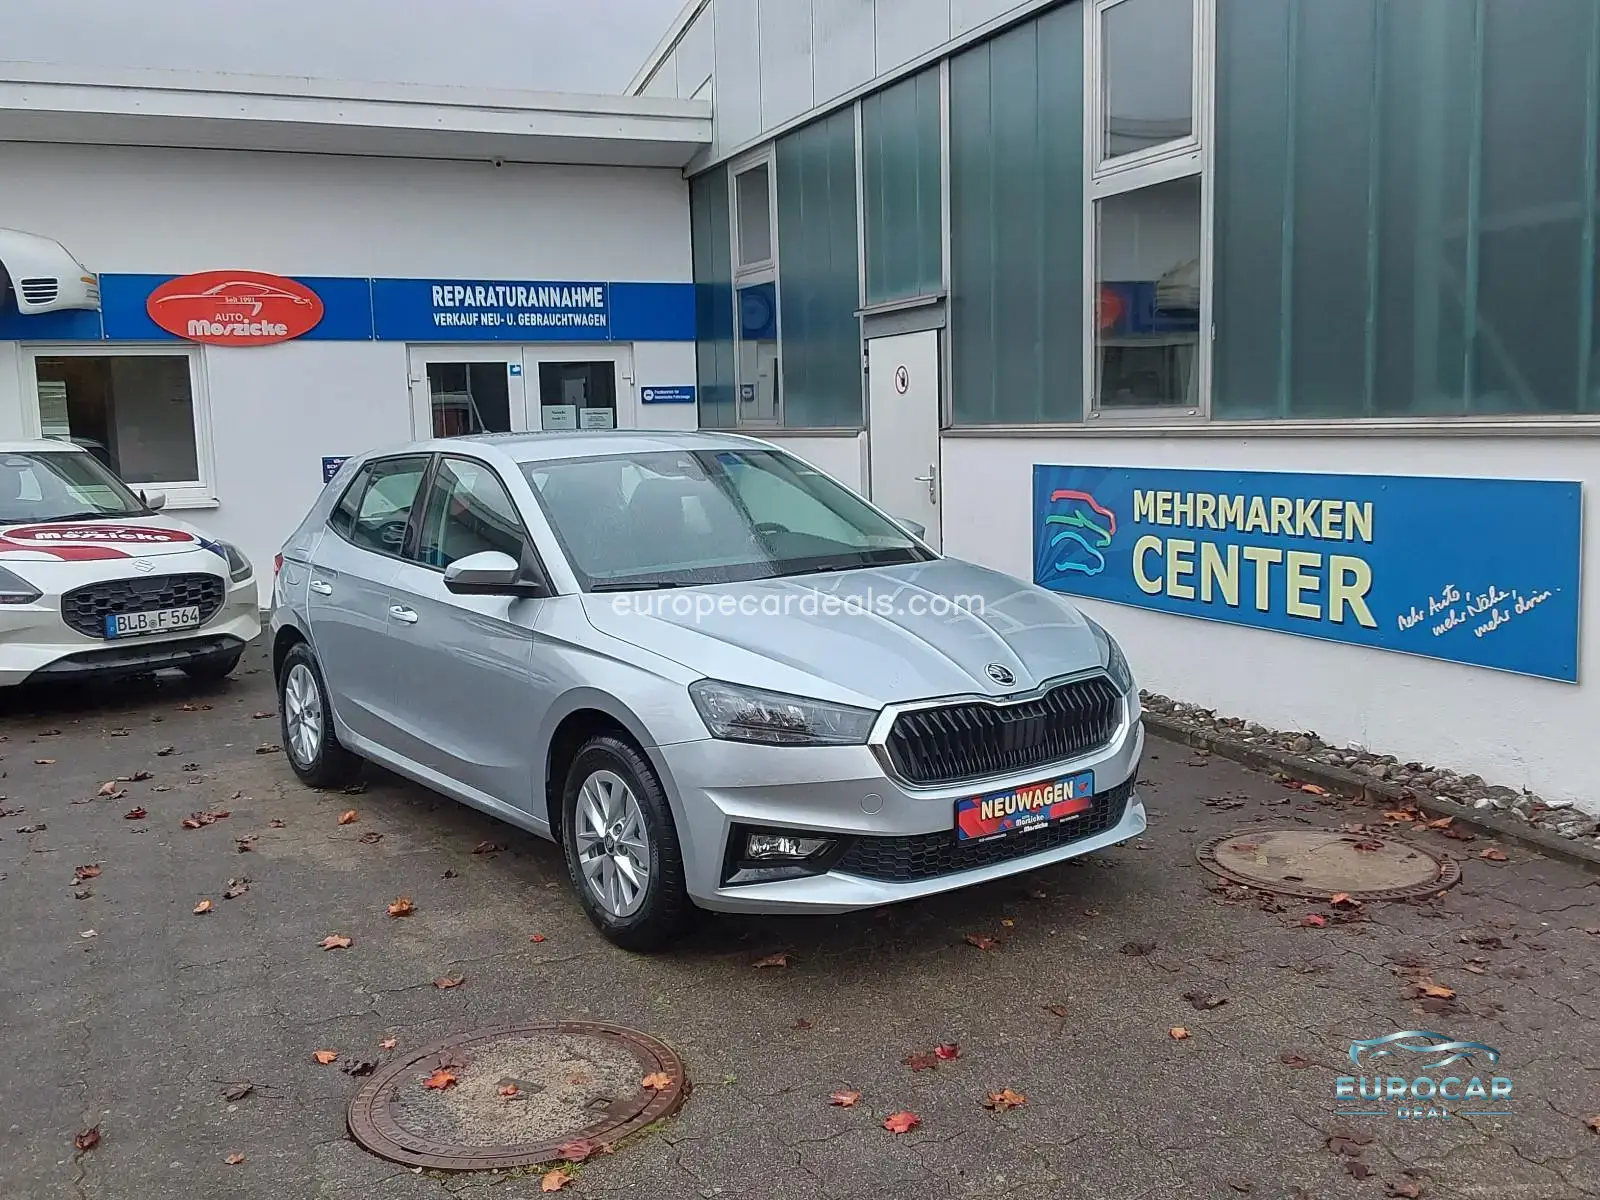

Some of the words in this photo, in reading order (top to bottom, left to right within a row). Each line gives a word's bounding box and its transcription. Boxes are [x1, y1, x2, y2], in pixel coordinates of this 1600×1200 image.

[432, 285, 604, 308] REPARATURANNAHME
[215, 313, 243, 321] AUTO
[433, 312, 479, 326] VERKAUF
[481, 312, 505, 326] NEU-
[506, 313, 517, 326] U.
[518, 313, 607, 326] GEBRAUCHTWAGEN
[1133, 489, 1374, 542] MEHRMARKEN
[1132, 535, 1378, 628] CENTER
[117, 614, 148, 631] BLB
[158, 611, 167, 627] F
[171, 607, 198, 625] 564
[1432, 609, 1467, 637] mehr
[1474, 608, 1511, 638] mehr
[981, 780, 1074, 821] NEUWAGEN
